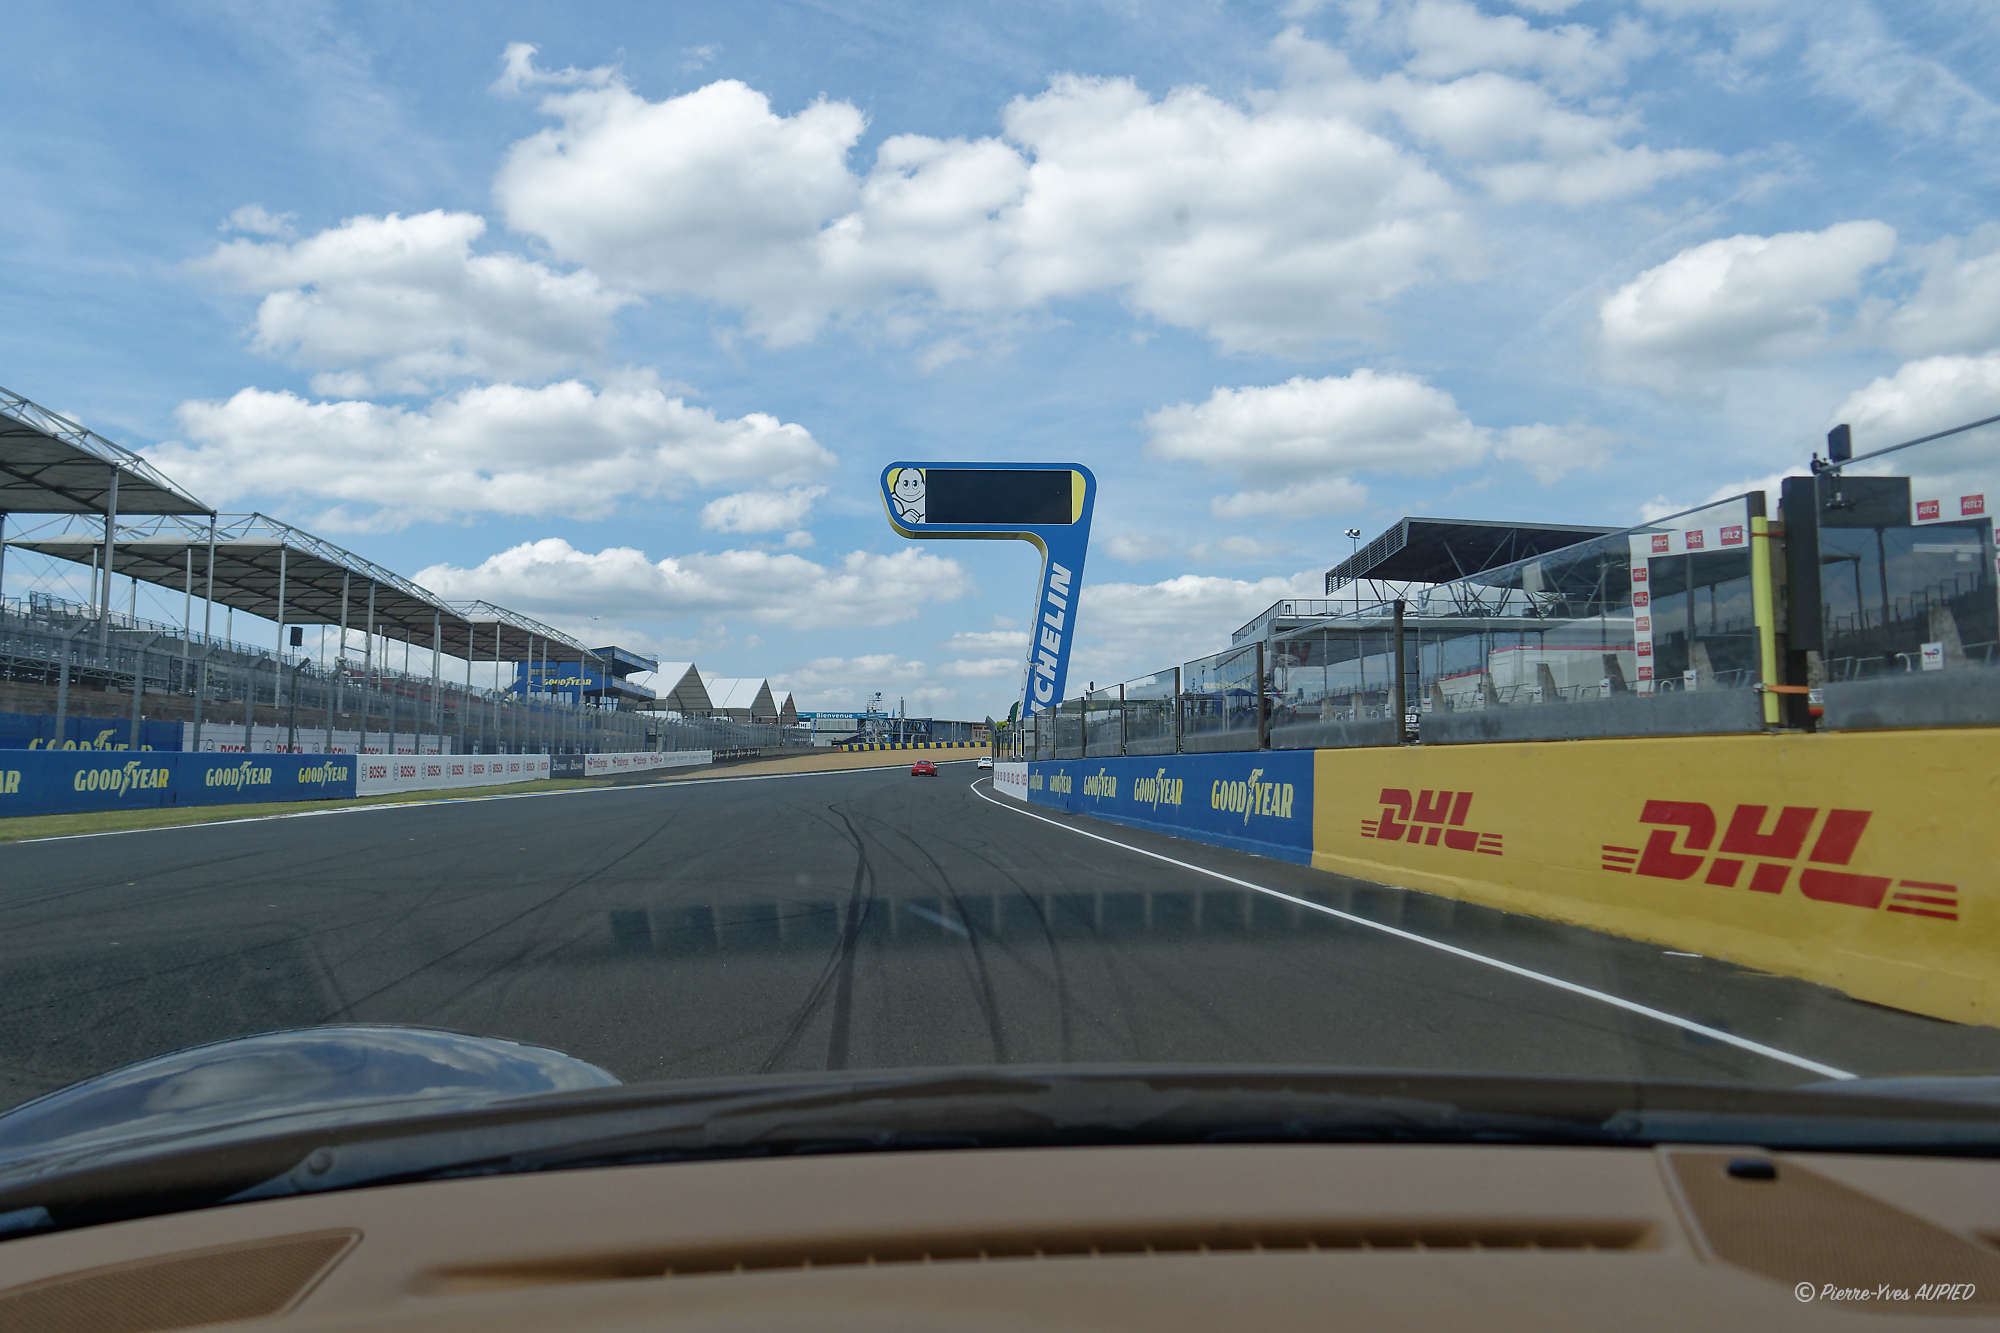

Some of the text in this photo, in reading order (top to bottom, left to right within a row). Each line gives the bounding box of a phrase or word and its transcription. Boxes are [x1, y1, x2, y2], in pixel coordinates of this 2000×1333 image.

[1030, 562, 1072, 713] ICHELIN
[73, 767, 170, 792] GOODYEAR
[205, 766, 272, 787] GOODYEAR
[298, 765, 348, 784] GOODYEAR
[369, 765, 387, 778] BOSCH
[400, 765, 416, 778] BOSCH
[427, 765, 441, 776] BOSCH
[1083, 775, 1117, 799] GOODYEAR
[1133, 776, 1183, 806] GOODYEAR
[1210, 778, 1294, 819] GOODYEAR
[1377, 788, 1480, 852] DHL
[1635, 799, 1893, 910] DHL
